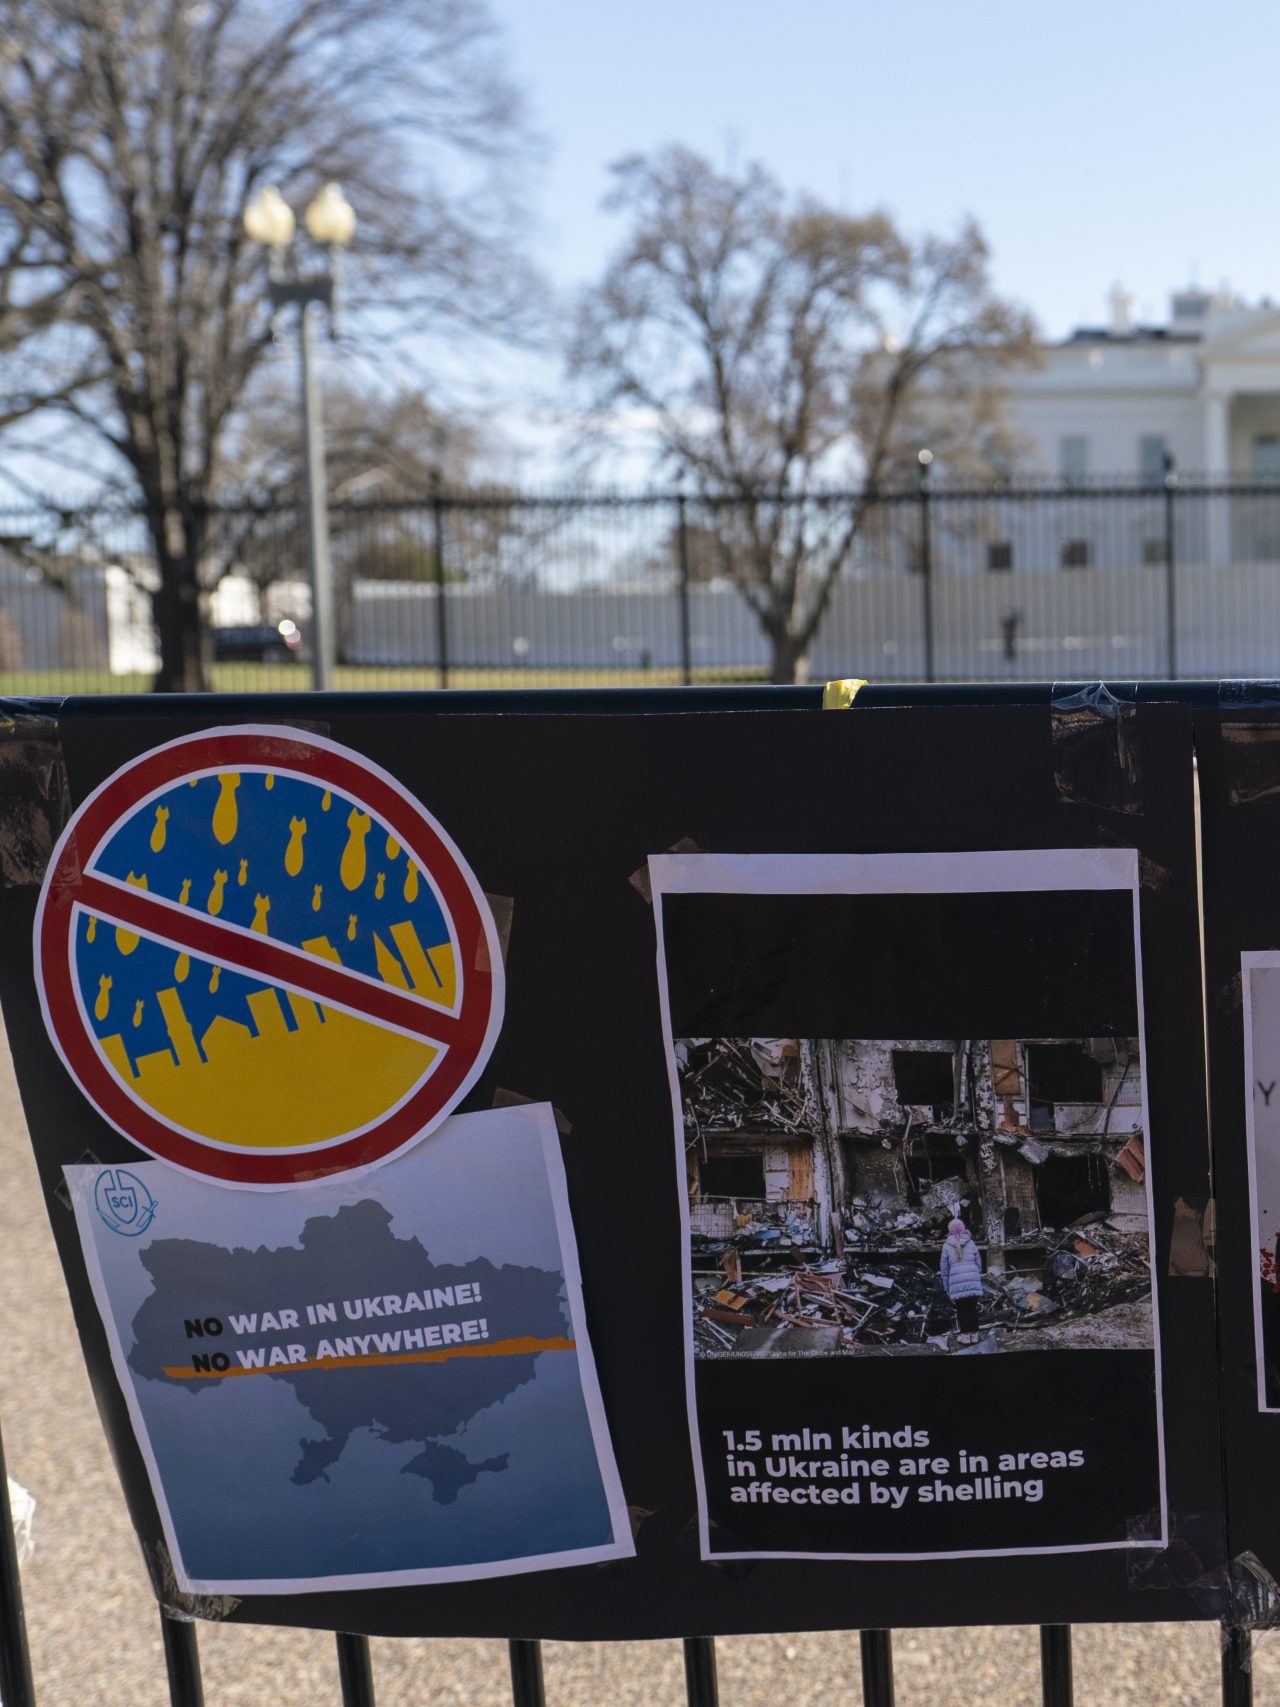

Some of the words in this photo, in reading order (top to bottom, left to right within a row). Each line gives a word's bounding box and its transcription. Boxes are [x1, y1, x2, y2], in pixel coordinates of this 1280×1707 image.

[111, 1195, 134, 1209] SCI
[183, 1316, 224, 1339] NO
[227, 1308, 301, 1335] WAR
[305, 1301, 338, 1326] IN
[343, 1281, 483, 1321] UKRAINE!
[191, 1351, 231, 1374] NO
[235, 1343, 309, 1370] WAR
[315, 1318, 490, 1361] ANYWHERE!
[722, 1429, 763, 1452] 1.5
[771, 1427, 833, 1452] mln
[841, 1424, 931, 1450] kinds
[726, 1454, 757, 1477] in
[765, 1453, 890, 1478] Ukraine
[898, 1456, 951, 1476] are
[958, 1449, 989, 1474] in
[997, 1449, 1086, 1472] areas
[730, 1481, 861, 1505] affected
[869, 1481, 910, 1510] by
[917, 1475, 1045, 1503] shelling
